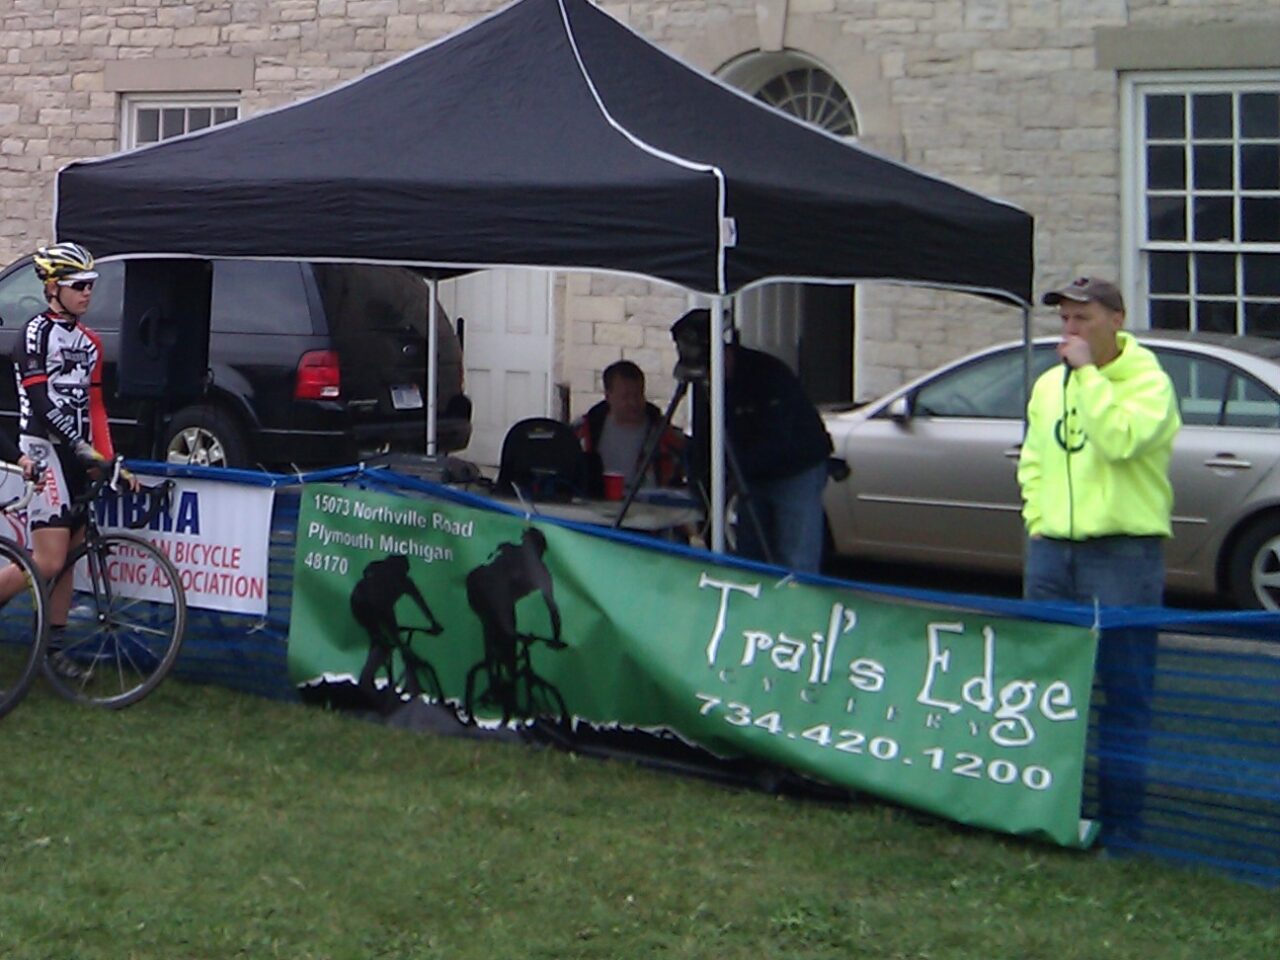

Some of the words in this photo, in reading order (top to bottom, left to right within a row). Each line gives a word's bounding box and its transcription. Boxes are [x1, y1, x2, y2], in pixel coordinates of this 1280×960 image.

[314, 493, 350, 516] 15073
[352, 501, 427, 529] Northville
[431, 512, 474, 538] Road
[174, 542, 242, 570] BICYCLE
[308, 522, 375, 551] Plymouth
[378, 534, 454, 563] Michigan
[150, 564, 264, 600] ASOCIATION
[304, 551, 349, 576] 48170
[698, 571, 887, 692] Trail's
[916, 621, 1079, 747] Edge
[694, 691, 1054, 790] 734.420.1200
